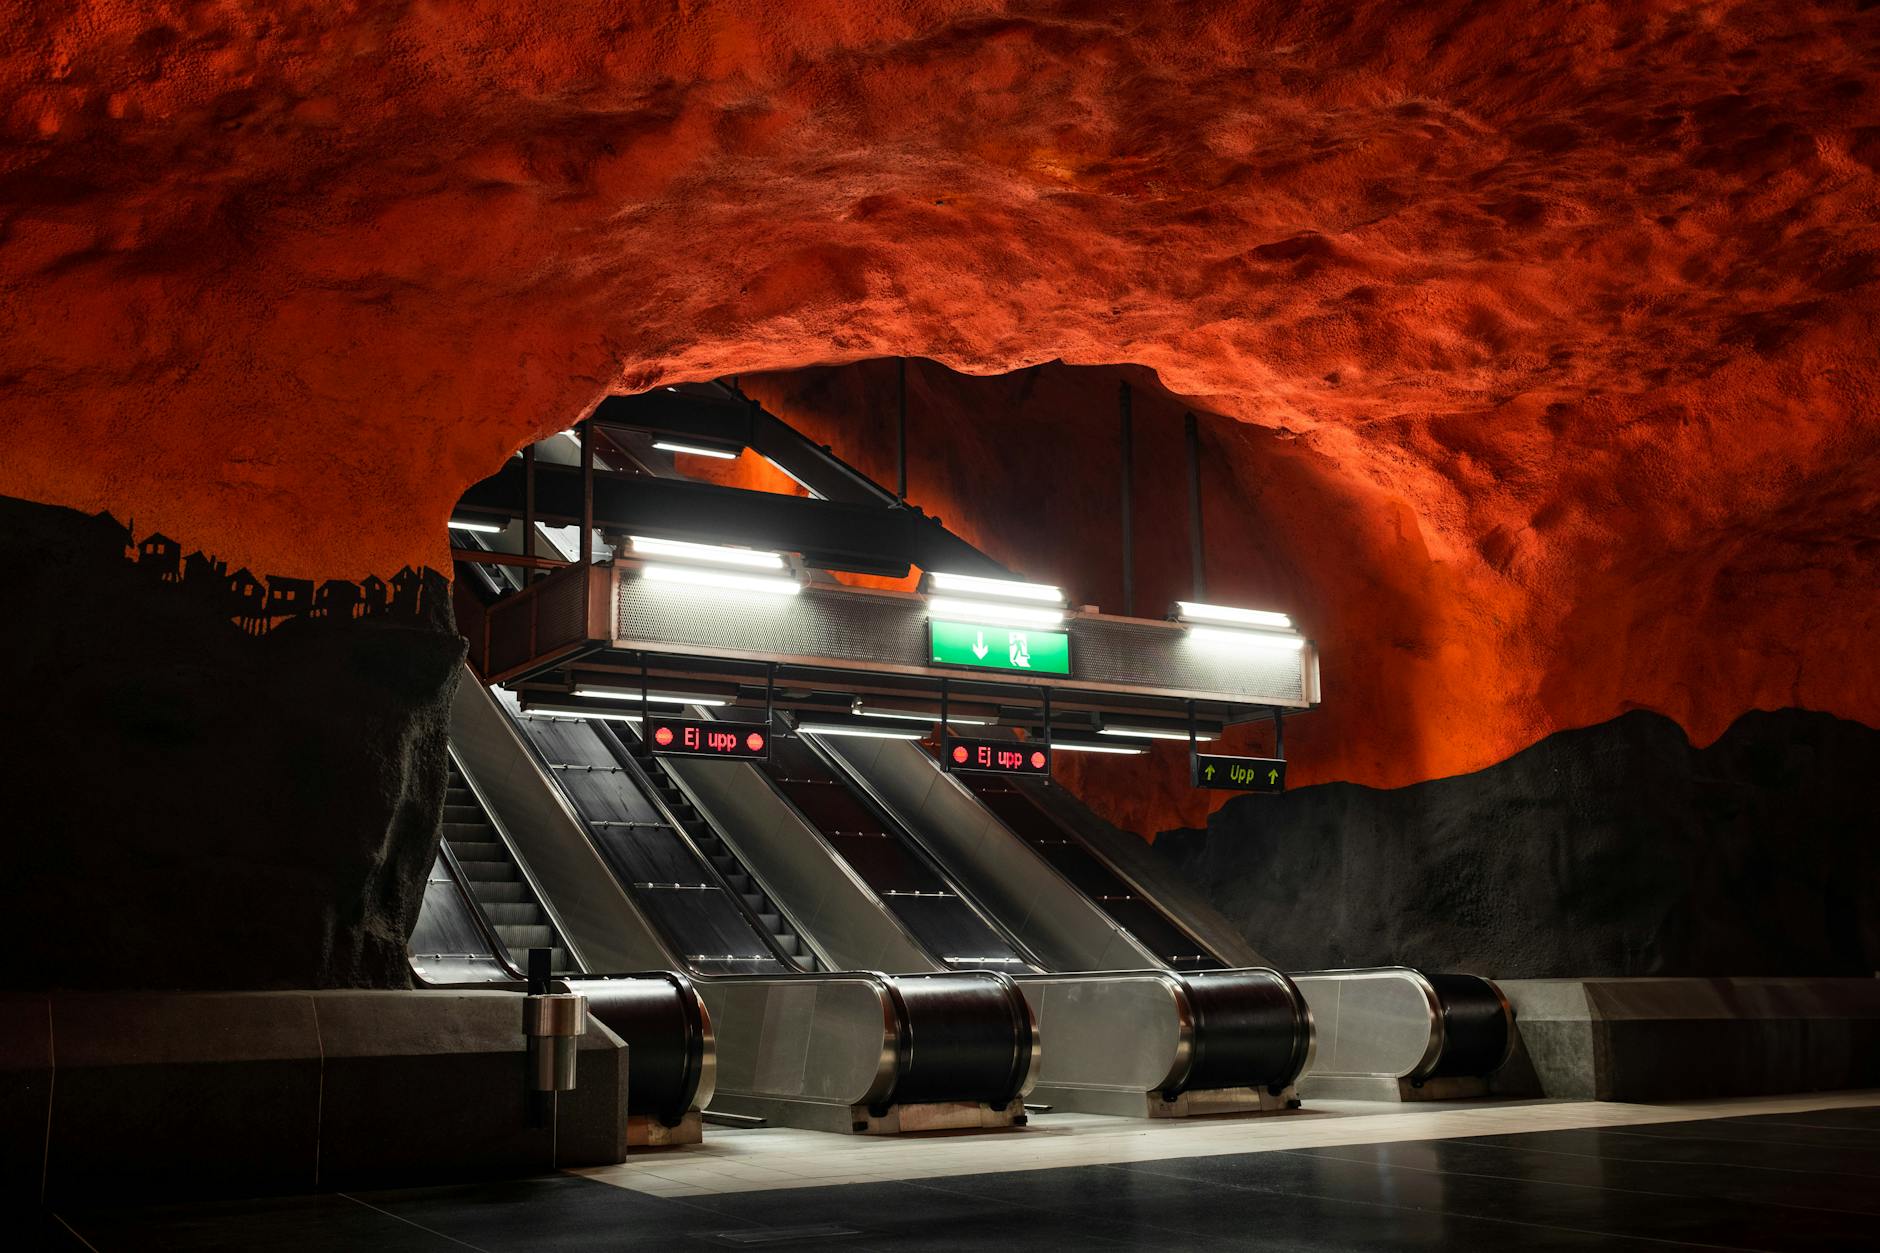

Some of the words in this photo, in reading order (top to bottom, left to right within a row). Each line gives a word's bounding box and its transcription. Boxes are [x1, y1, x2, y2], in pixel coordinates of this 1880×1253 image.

[684, 727, 700, 750] Ej
[708, 732, 737, 752] upp
[978, 746, 991, 767] Ej
[998, 751, 1023, 769] upp
[1230, 764, 1255, 784] Upp
